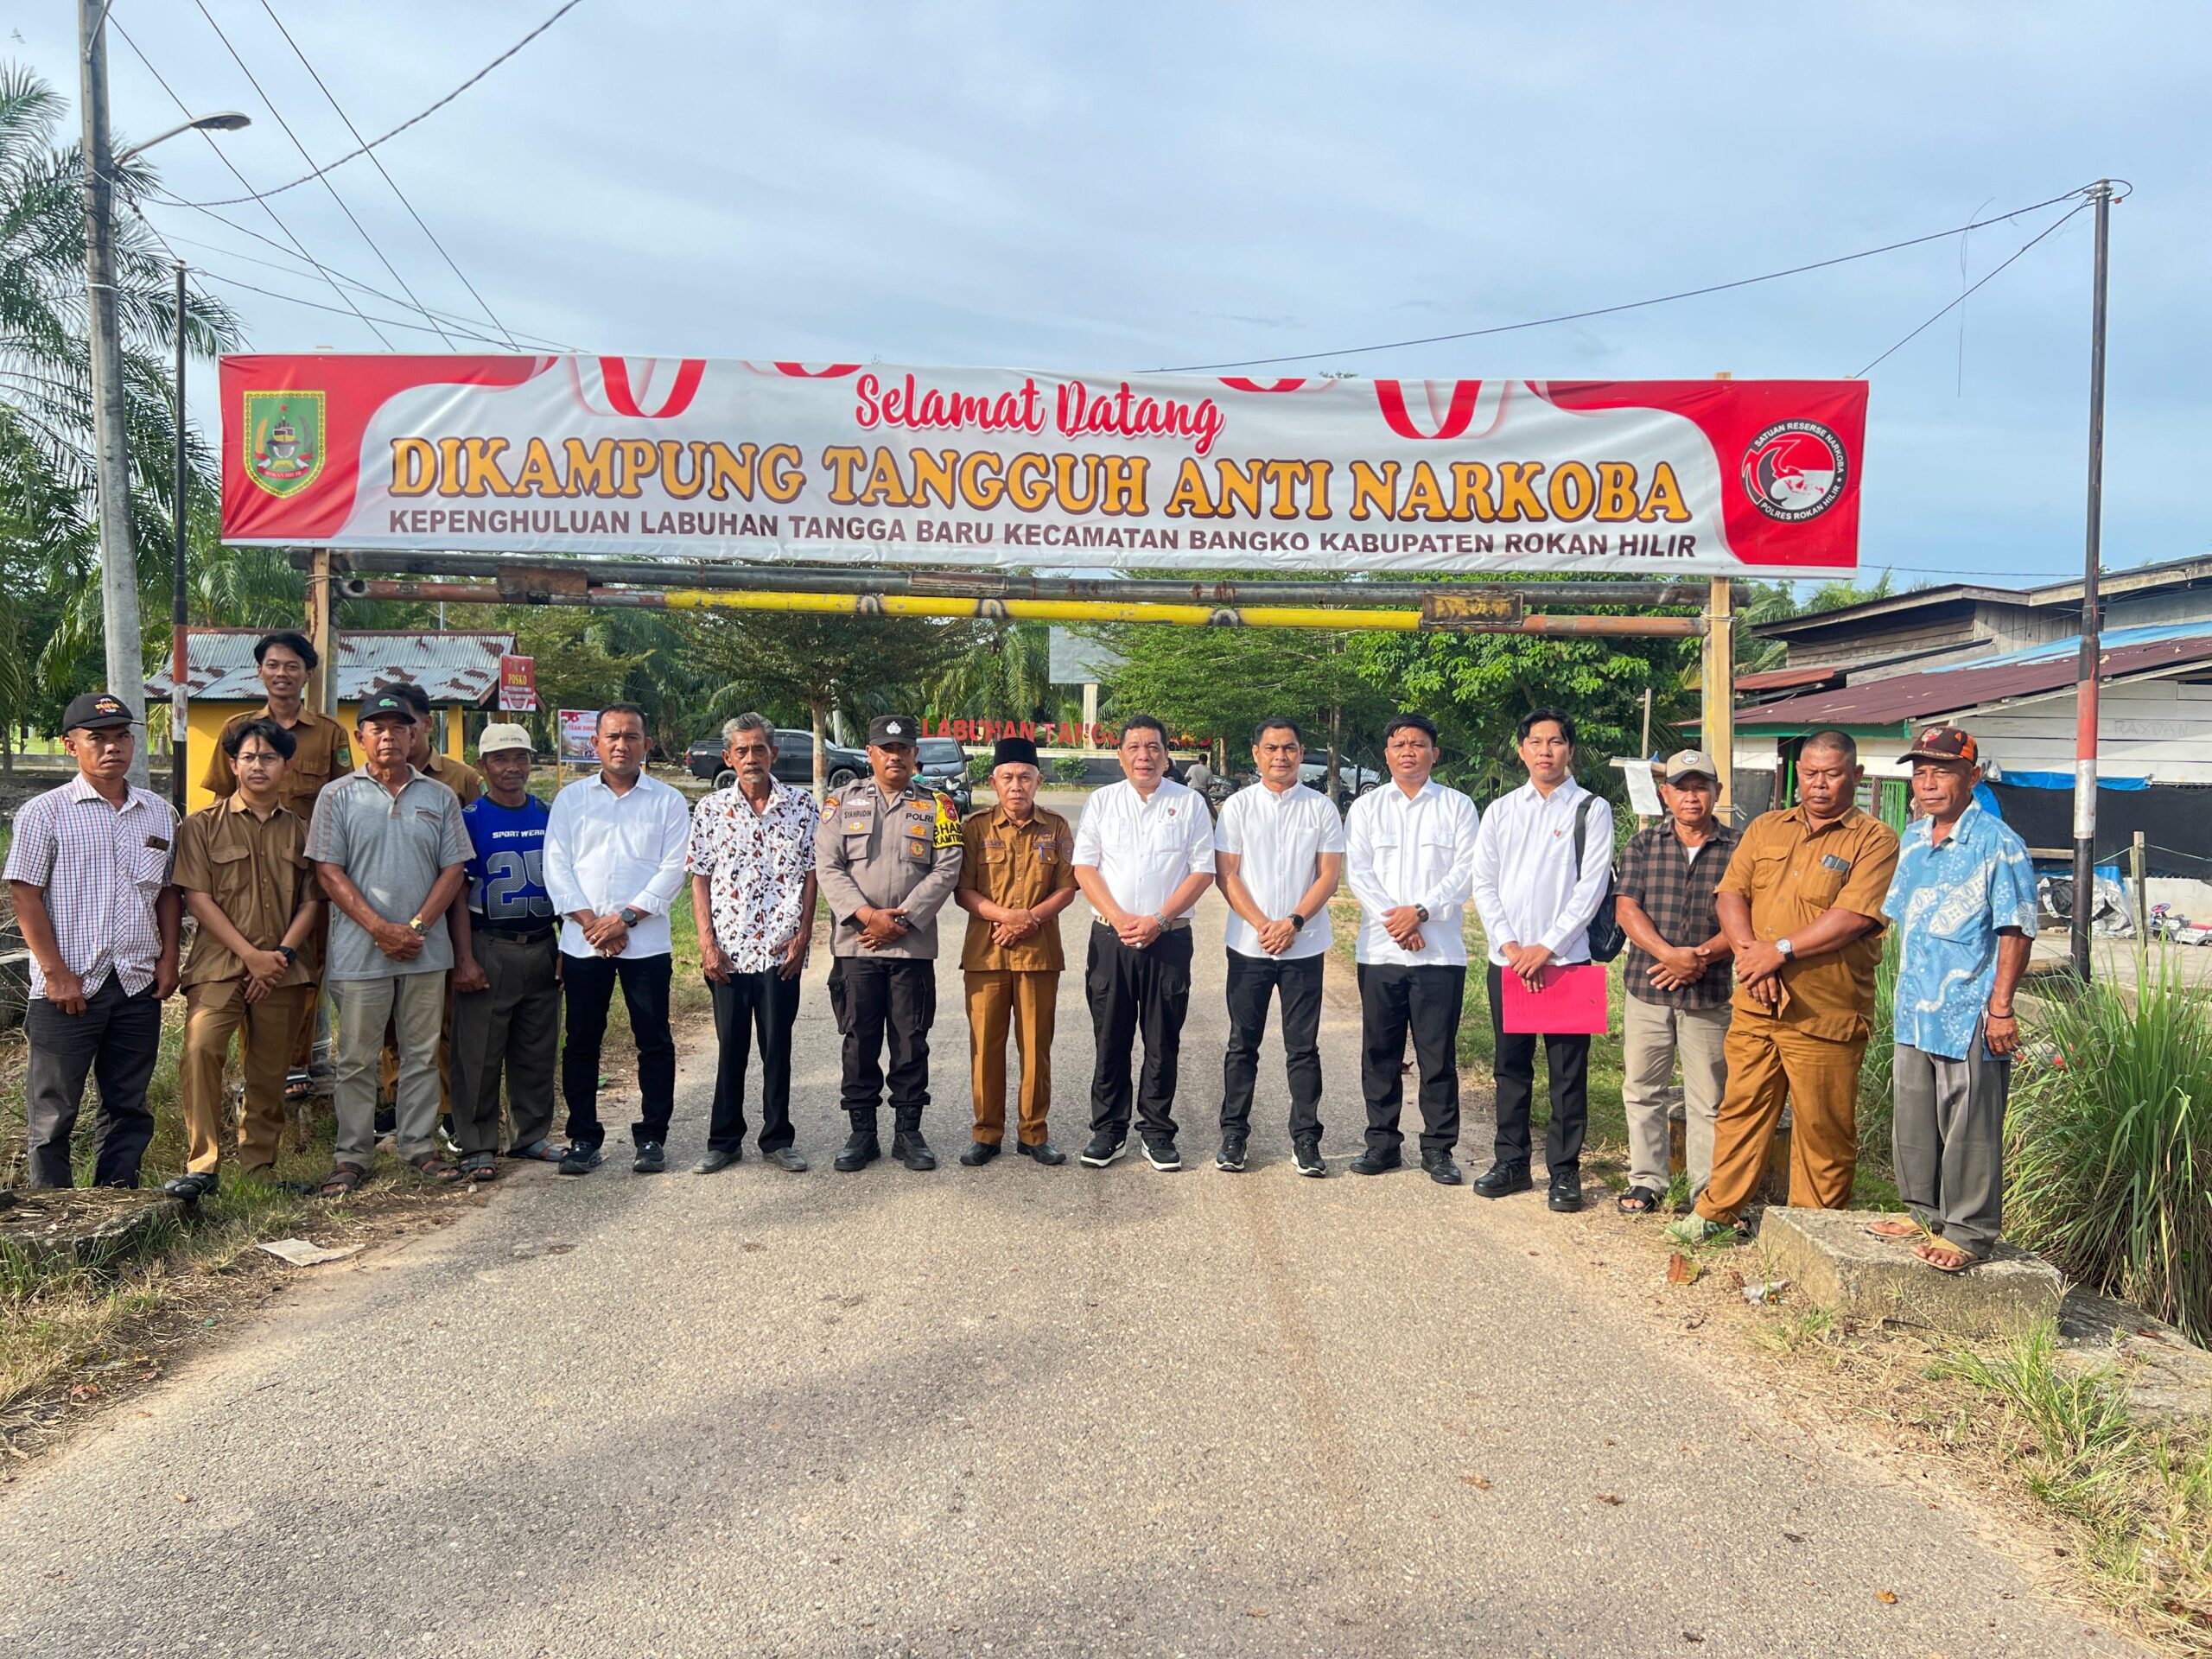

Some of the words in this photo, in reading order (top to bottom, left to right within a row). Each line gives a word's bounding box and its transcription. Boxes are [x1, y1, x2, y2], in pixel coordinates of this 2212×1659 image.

[855, 374, 1046, 431] Selamat
[1057, 381, 1225, 454] Datang
[1754, 424, 1785, 447] SATUAN
[1787, 423, 1827, 436] RESERSE
[1825, 435, 1845, 474] NARKOBA
[389, 436, 807, 503] DIKAMPUNG
[823, 445, 1151, 517] TANGGUH
[1166, 457, 1332, 520] ANTI
[1349, 458, 1694, 523] NARKOBA
[1760, 502, 1792, 520] POLRES
[1793, 505, 1824, 520] ROKAN
[1823, 485, 1841, 506] HILIR
[390, 510, 630, 534] KEPENGHULUAN
[641, 512, 779, 537] LABUHAN
[789, 516, 907, 542] TANGGA
[916, 520, 994, 544] BARU
[1004, 524, 1179, 550] KECAMATAN
[1189, 531, 1309, 552] BANGKO
[1320, 532, 1495, 553] KABUPATEN
[1504, 533, 1607, 556] ROKAN
[1618, 534, 1696, 557] HILIR
[507, 674, 528, 685] POSKO
[921, 718, 1035, 742] LABUHAN
[844, 810, 872, 819] SYAHRUDIN
[906, 813, 934, 823] POLRI
[493, 830, 519, 839] SPORT
[521, 829, 545, 837] WEAR
[933, 823, 963, 836] BHAB
[486, 850, 554, 918] 25
